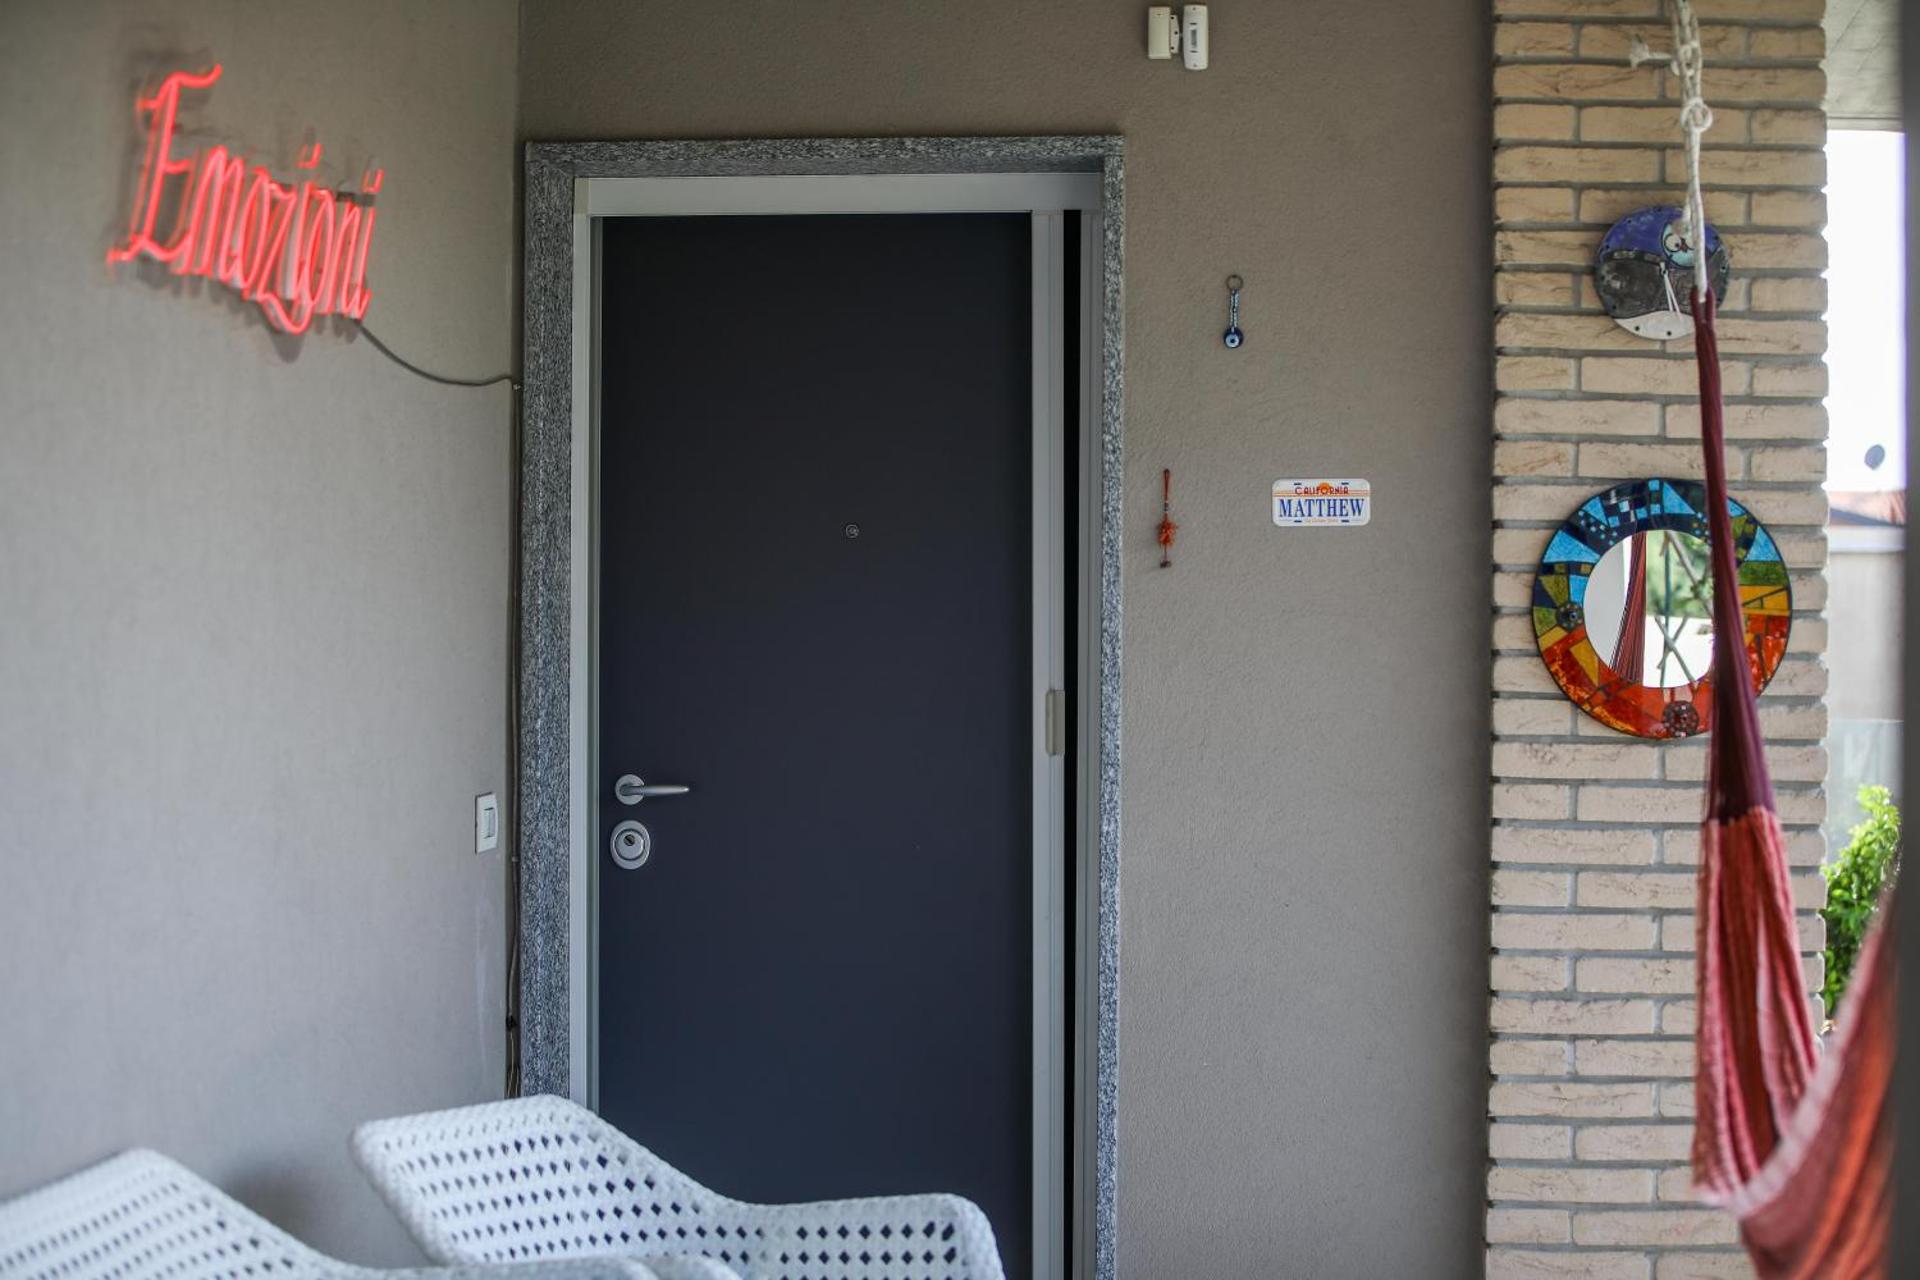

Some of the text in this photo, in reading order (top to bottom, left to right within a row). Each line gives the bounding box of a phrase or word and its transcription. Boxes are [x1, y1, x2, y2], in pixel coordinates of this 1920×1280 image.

[106, 63, 384, 334] Emozioni
[1295, 486, 1349, 495] CALIFORNIA
[1279, 498, 1364, 517] MATTHEW
